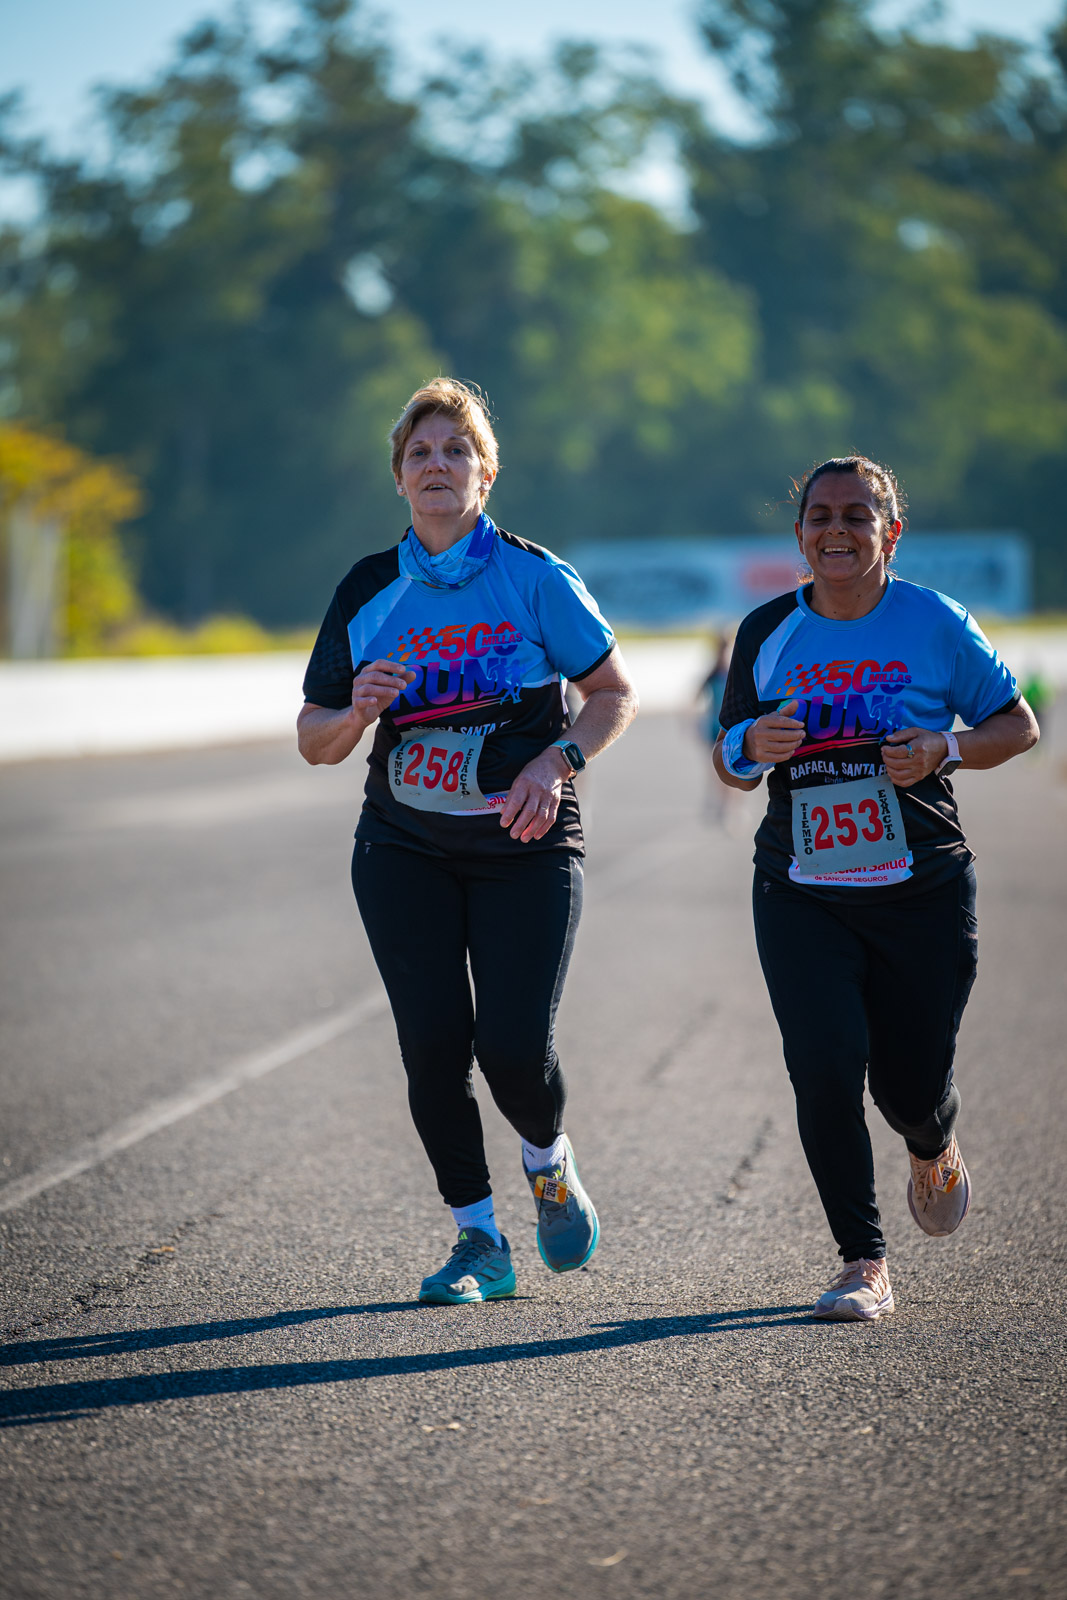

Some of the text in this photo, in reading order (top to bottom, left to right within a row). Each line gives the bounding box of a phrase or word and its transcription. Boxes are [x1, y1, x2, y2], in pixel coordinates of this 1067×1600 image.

[438, 621, 517, 660] 500
[482, 633, 524, 646] MILLAS
[823, 660, 909, 695] 500
[869, 673, 912, 684] MILLAS
[403, 743, 464, 793] 258
[459, 748, 474, 795] EXACTO
[790, 760, 839, 781] RAFAELA,
[842, 762, 876, 777] SANTA
[801, 803, 813, 855] TIEMPO
[811, 799, 884, 850] 253
[877, 789, 895, 841] EXACTO
[546, 1182, 558, 1198] 258
